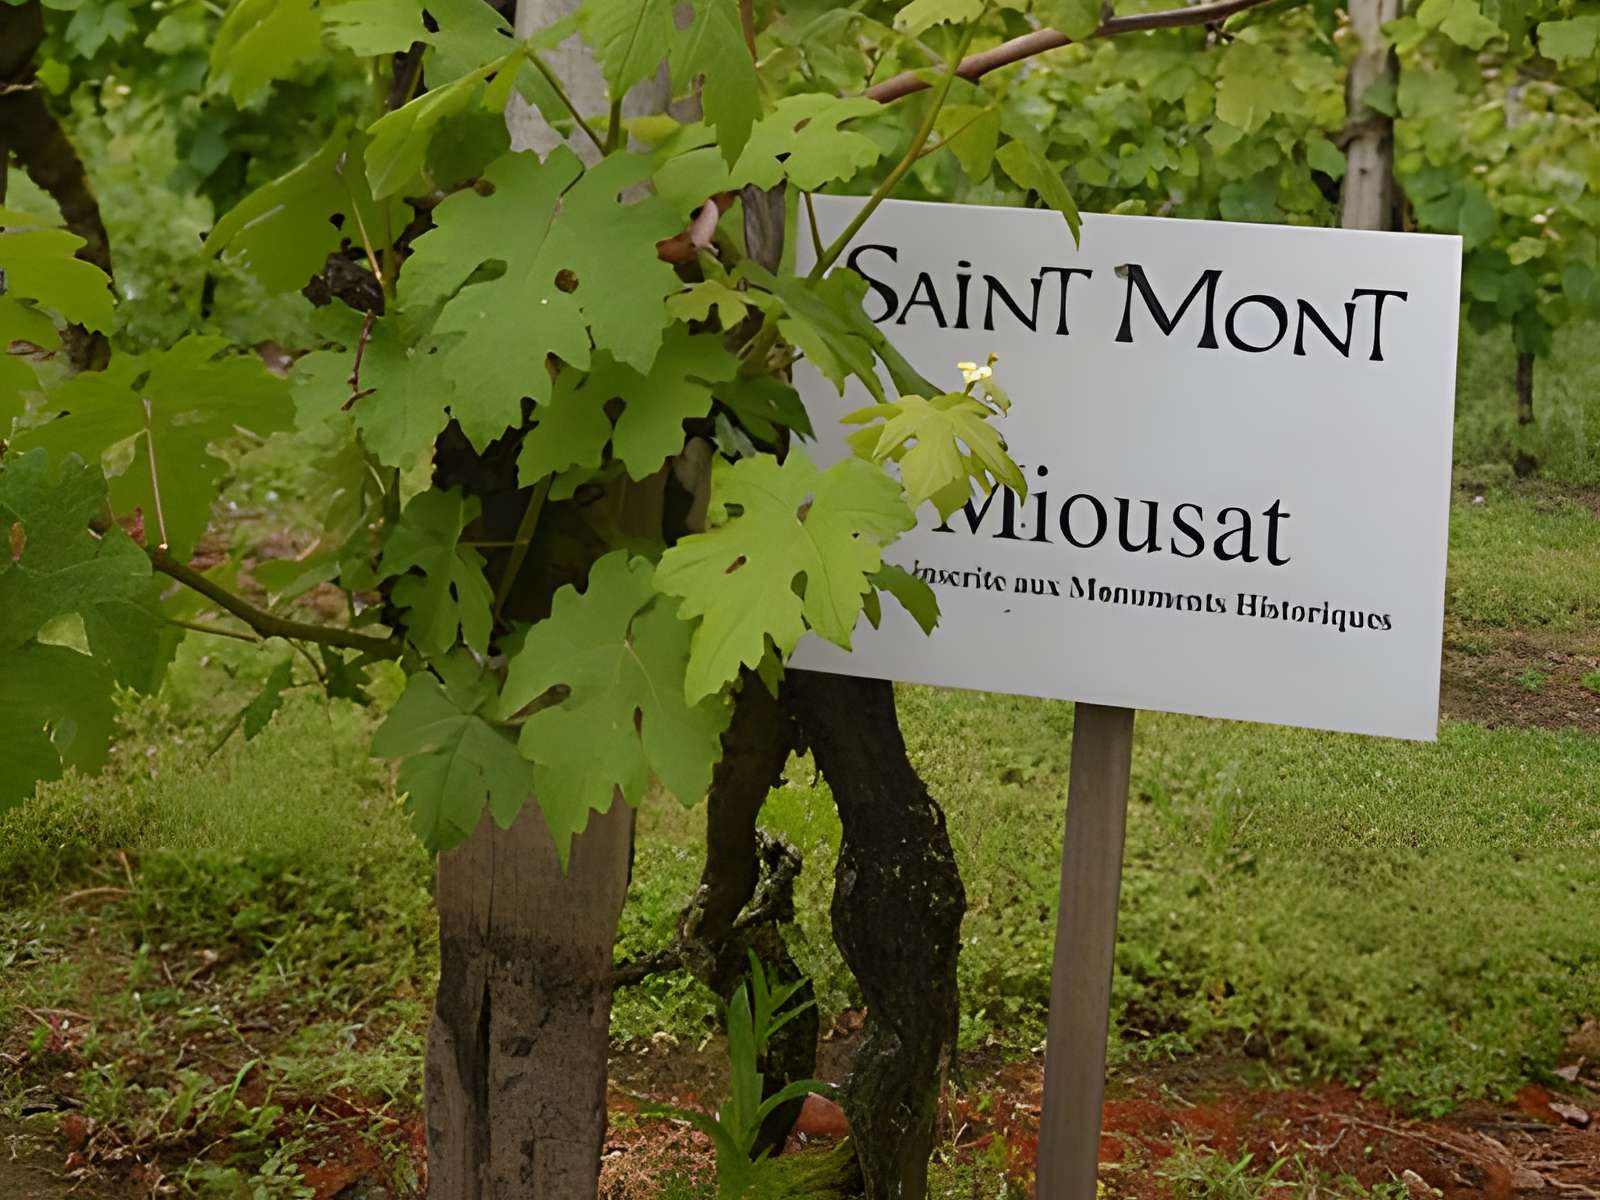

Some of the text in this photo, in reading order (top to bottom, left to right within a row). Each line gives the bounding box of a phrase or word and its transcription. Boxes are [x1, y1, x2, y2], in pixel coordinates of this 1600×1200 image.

[1114, 264, 1408, 361] MONT
[1014, 577, 1060, 597] aux
[1069, 576, 1227, 613] Monuments
[1237, 593, 1392, 633] Historiques
